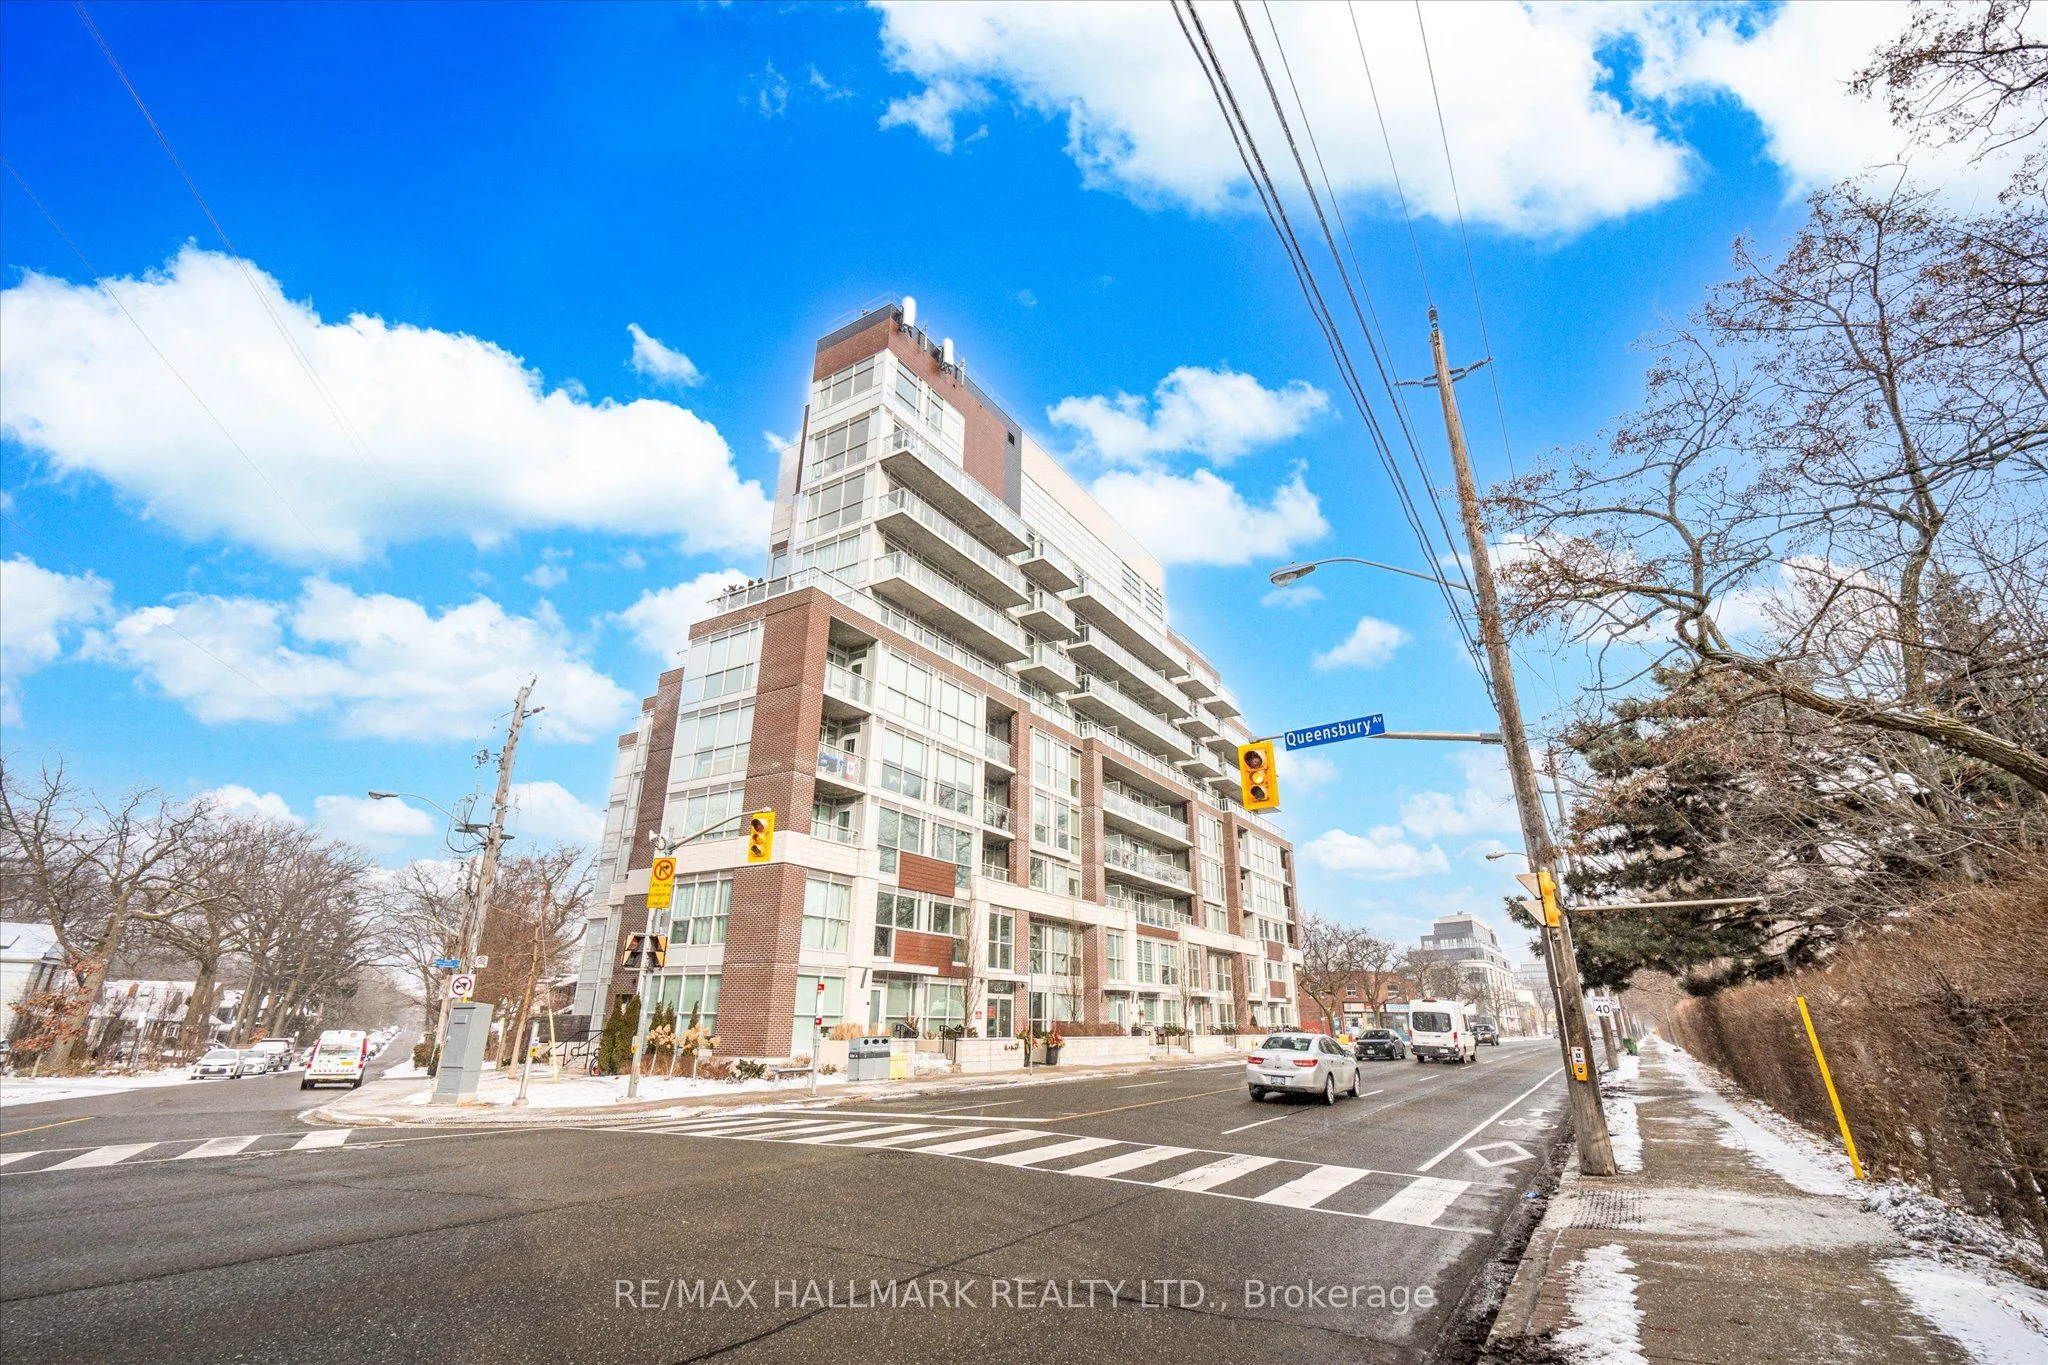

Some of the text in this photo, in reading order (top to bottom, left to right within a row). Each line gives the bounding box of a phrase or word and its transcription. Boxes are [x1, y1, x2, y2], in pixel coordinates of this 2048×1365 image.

[1286, 715, 1383, 746] Queensbury Av
[1595, 1004, 1610, 1013] 40
